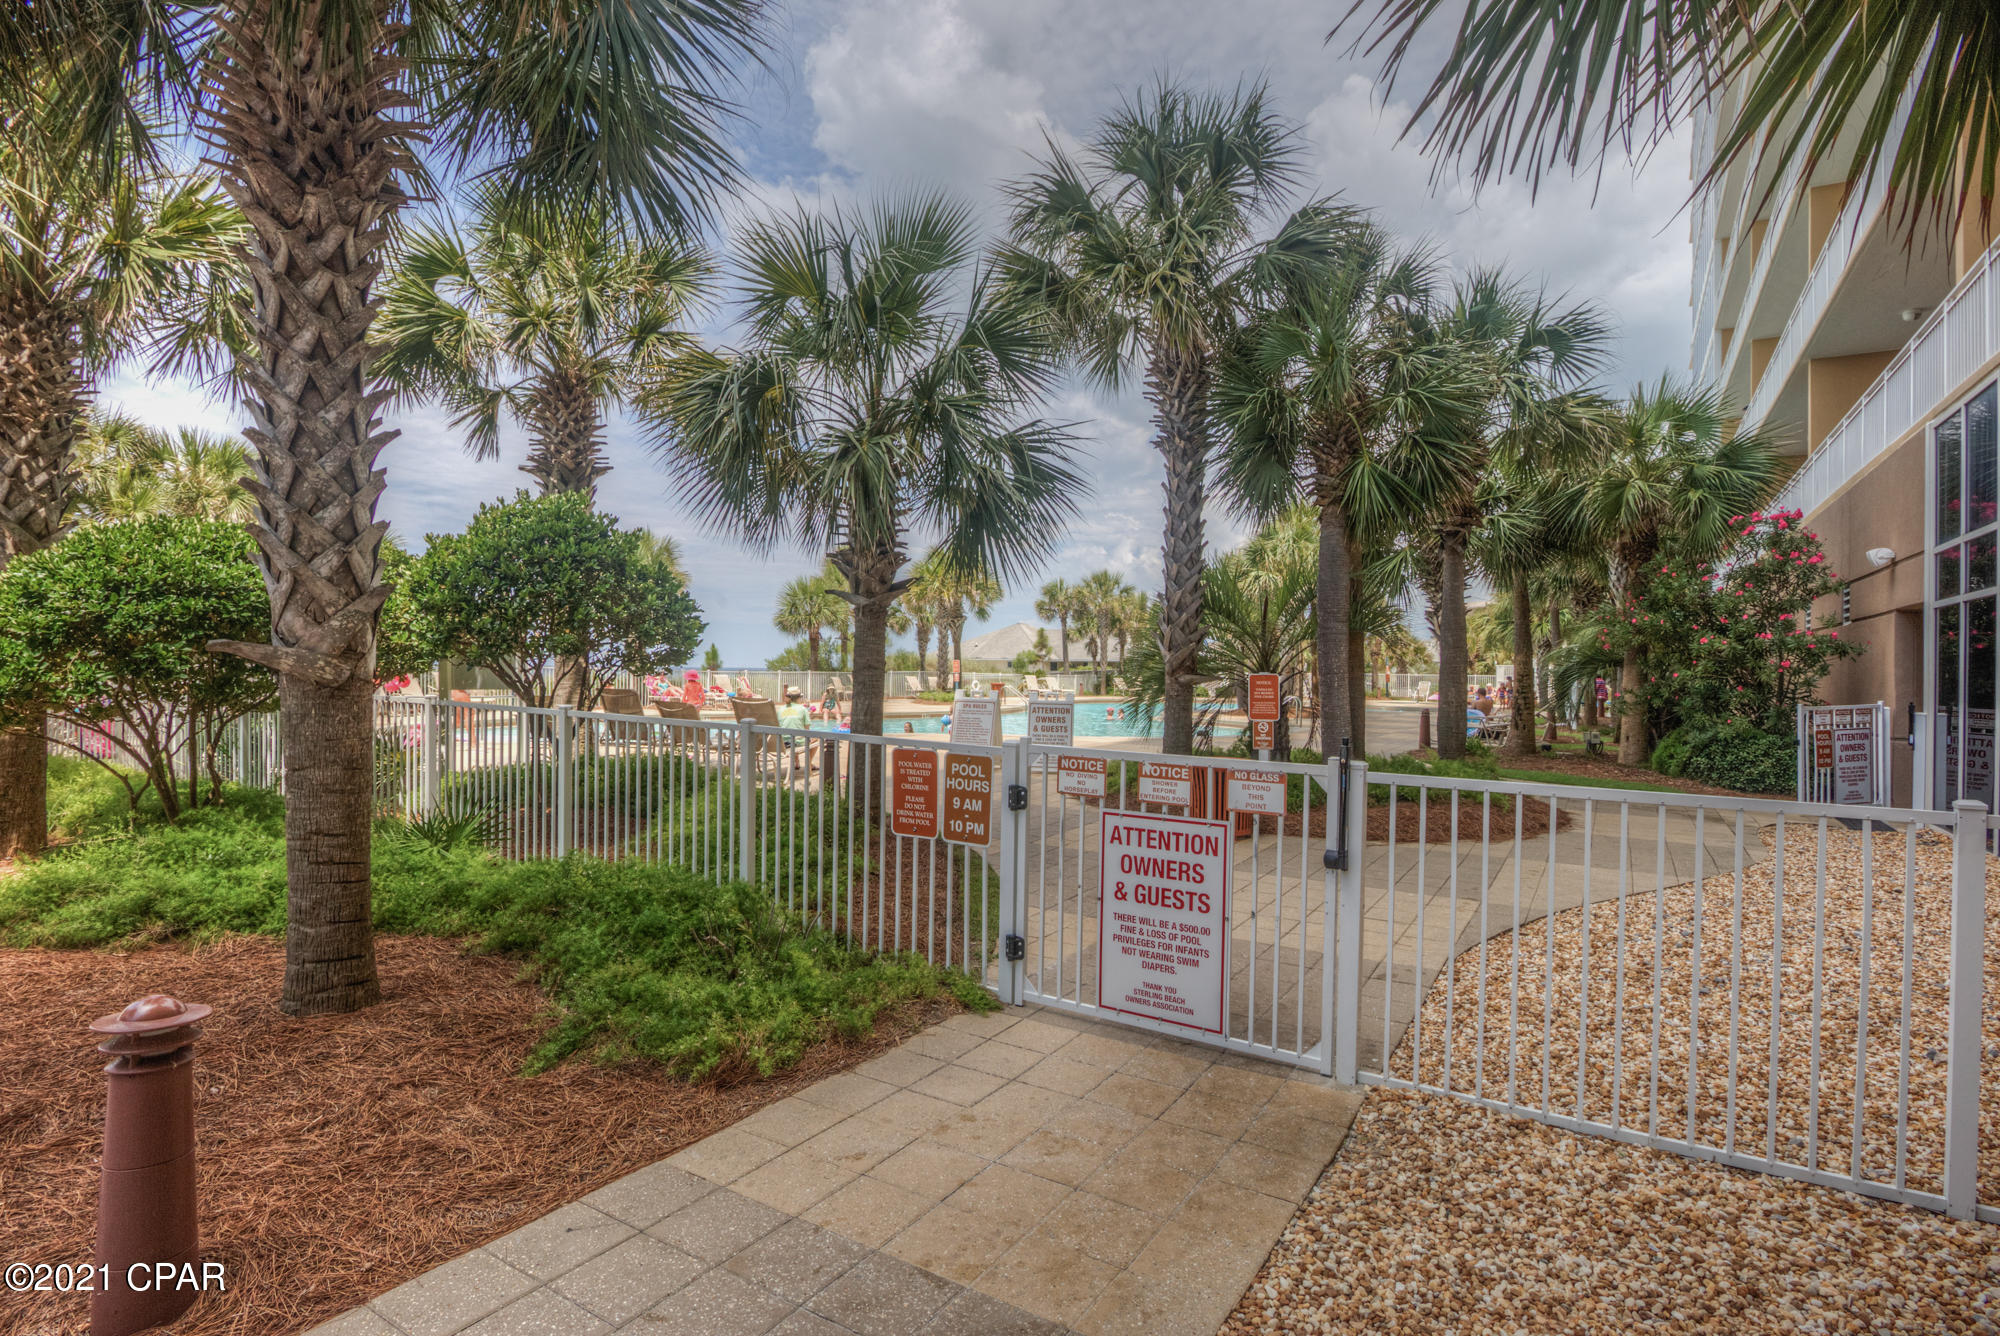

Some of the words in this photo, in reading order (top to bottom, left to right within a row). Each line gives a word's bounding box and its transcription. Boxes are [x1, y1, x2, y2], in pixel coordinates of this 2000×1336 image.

[1032, 706, 1070, 715] ATTENTION
[1035, 716, 1066, 724] OWNERS
[1033, 724, 1038, 733] &
[1041, 725, 1068, 733] GUESTS
[1836, 732, 1870, 741] ATTENTION
[1840, 743, 1865, 752] OWNERS
[1839, 755, 1844, 763] &
[1845, 753, 1868, 762] GUESTS
[1061, 759, 1104, 771] NOTICE
[906, 769, 931, 777] TREATED
[951, 763, 985, 778] POOL
[1142, 765, 1189, 779] NOTICE
[1234, 771, 1248, 780] NO
[1250, 772, 1280, 782] GLASS
[901, 783, 929, 791] CHLORINE
[946, 777, 990, 793] HOURS
[1152, 780, 1178, 788] SHOWER
[1241, 783, 1271, 792] BEYOND
[1064, 785, 1098, 795] HORSEPLAY
[1152, 787, 1177, 795] BEFORE
[905, 795, 925, 803] PLEASE
[1140, 792, 1170, 801] ENTERING
[1248, 793, 1264, 801] THIS
[952, 797, 960, 809] 9
[963, 798, 982, 812] AM
[1245, 802, 1267, 810] POINT
[896, 809, 914, 817] DRINK
[915, 811, 934, 819] WATER
[899, 817, 914, 825] FROM
[915, 818, 931, 826] POOL
[949, 819, 963, 832] 10
[965, 822, 984, 835] PM
[1110, 825, 1219, 857] ATTENTION
[1120, 854, 1205, 884] OWNERS
[1114, 881, 1128, 901] &
[1134, 884, 1211, 914] GUESTS
[1113, 912, 1136, 924] THERE
[1138, 916, 1157, 928] WILL
[1159, 920, 1169, 930] BE
[1171, 922, 1177, 931] A
[1179, 923, 1211, 936] $500.00
[1120, 925, 1137, 935] FINE
[1138, 928, 1145, 936] &
[1146, 929, 1166, 940] LOSS
[1168, 932, 1179, 941] OF
[1181, 935, 1202, 946] POOL
[1113, 933, 1156, 949] PRIVILEGES
[1157, 940, 1173, 951] FOR
[1175, 944, 1210, 959] INFANTS
[1121, 946, 1137, 956] NOT
[1139, 949, 1175, 964] WEARING
[1176, 956, 1200, 968] SWIM
[1142, 961, 1177, 975] DIAPERS.
[1142, 981, 1162, 992] THANK
[1164, 985, 1177, 995] YOU
[1133, 988, 1163, 1001] STERLING
[1164, 994, 1186, 1005] BEACH
[1125, 995, 1151, 1007] OWNERS
[1152, 1001, 1194, 1016] ASSOCIATION
